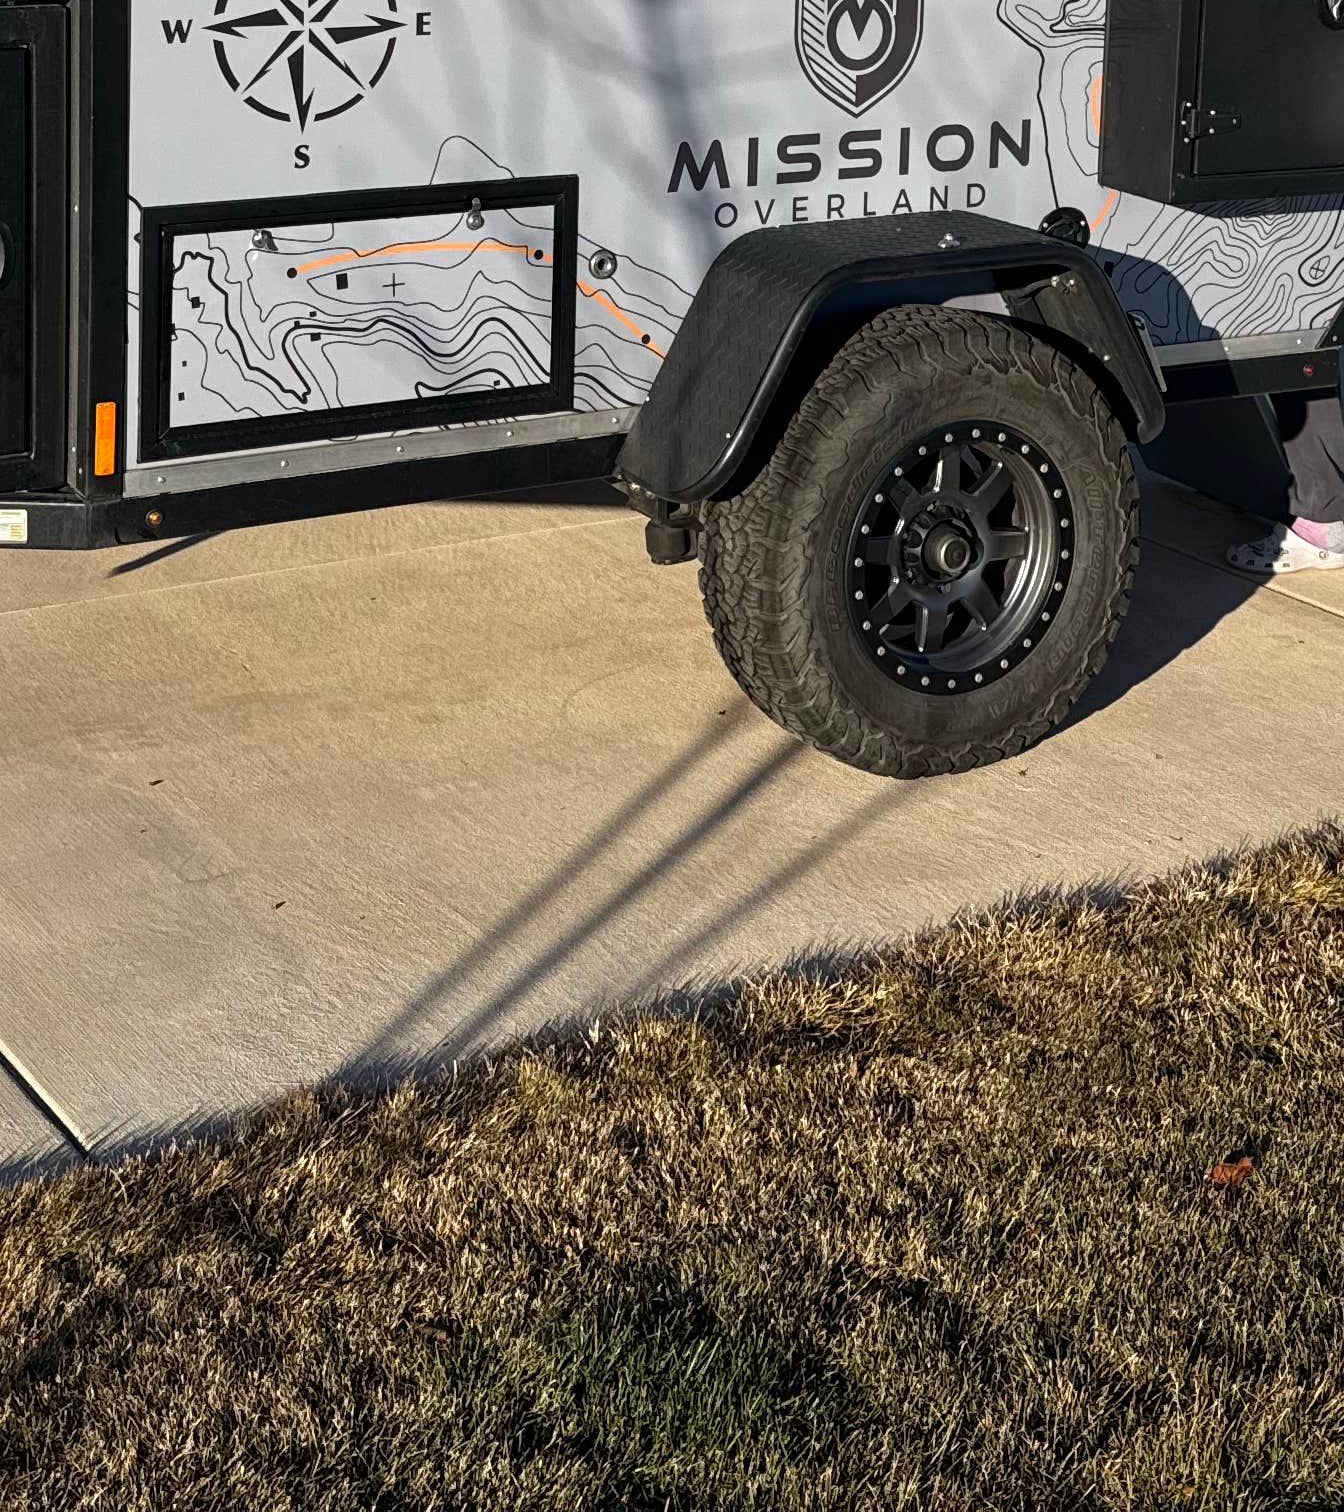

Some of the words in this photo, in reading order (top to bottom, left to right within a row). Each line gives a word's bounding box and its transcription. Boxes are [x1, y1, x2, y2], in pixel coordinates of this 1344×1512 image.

[161, 19, 193, 44] W
[415, 12, 432, 36] E
[294, 144, 311, 169] S
[667, 119, 1032, 193] MISSION
[714, 183, 987, 228] OVERLAND
